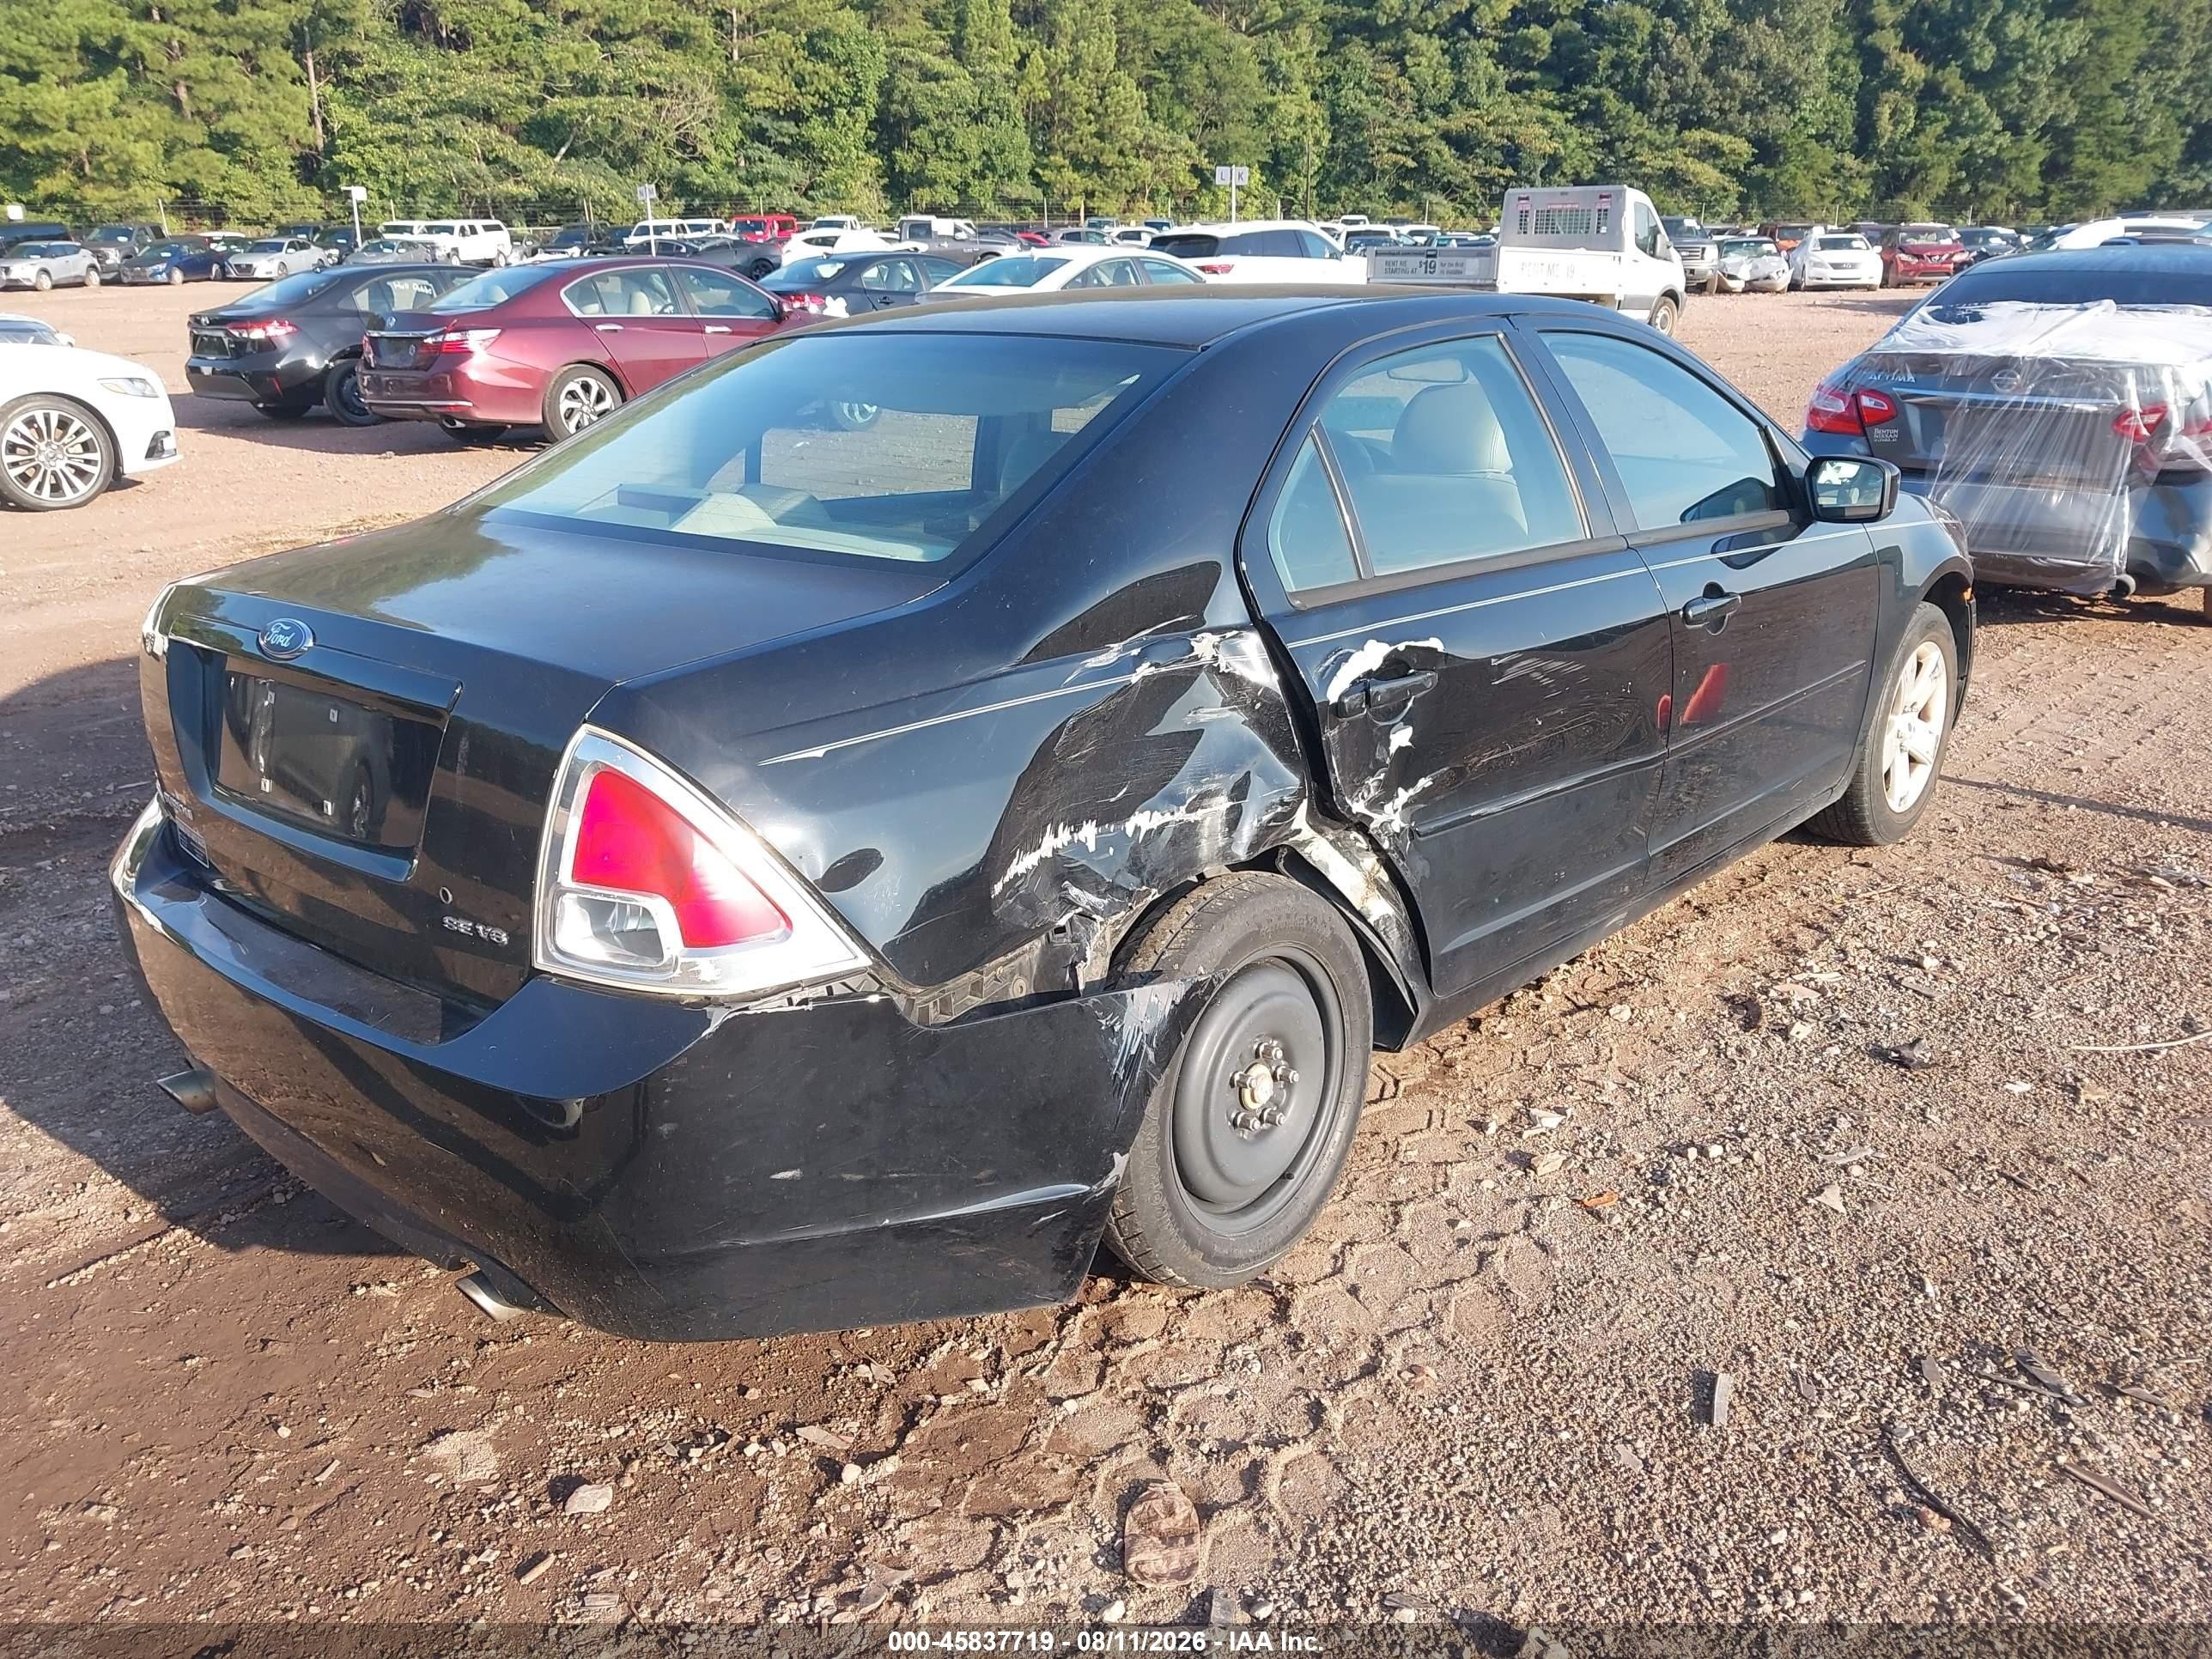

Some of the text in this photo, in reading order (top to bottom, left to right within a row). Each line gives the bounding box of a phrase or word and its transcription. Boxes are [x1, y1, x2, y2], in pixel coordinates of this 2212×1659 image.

[1419, 259, 1437, 275] $19
[264, 622, 296, 647] Ford
[442, 915, 510, 945] SE V6
